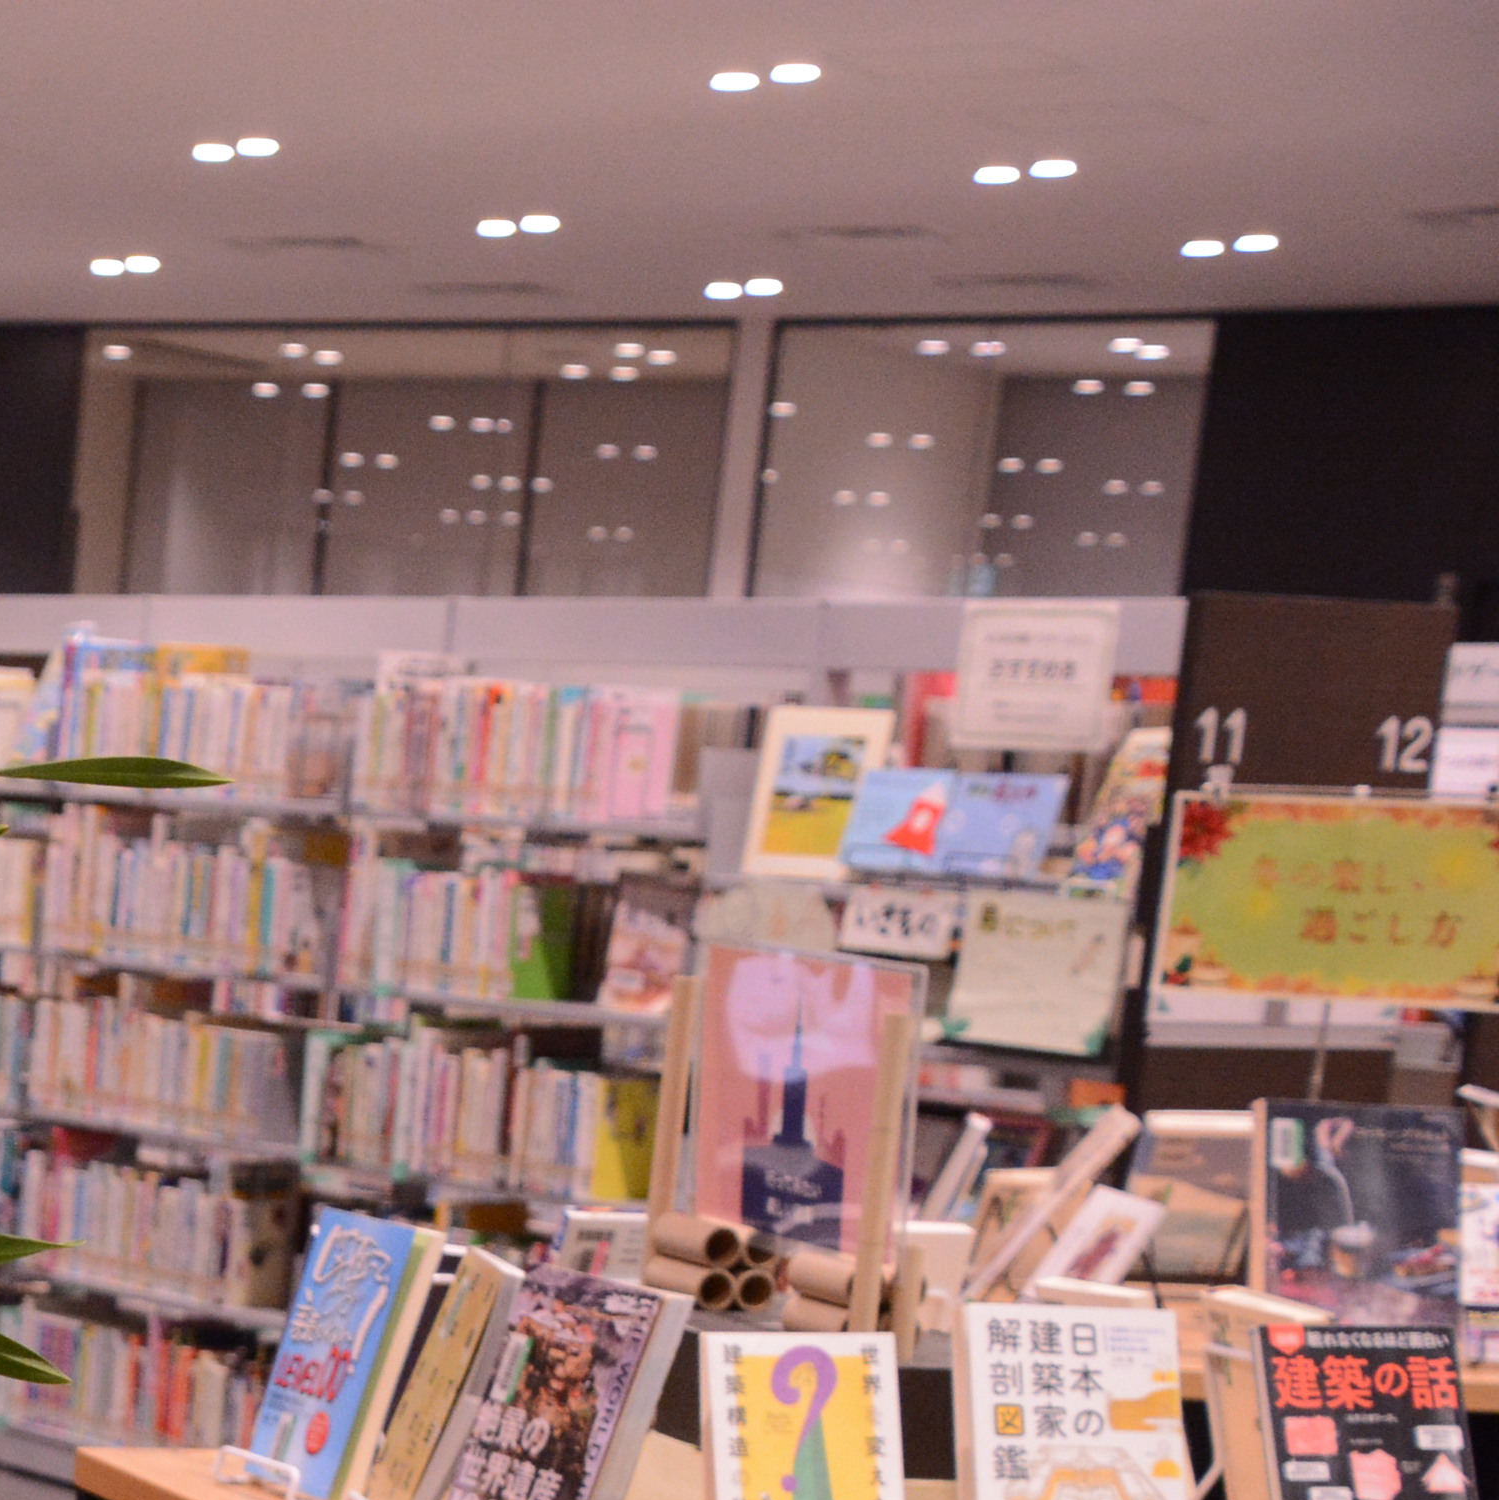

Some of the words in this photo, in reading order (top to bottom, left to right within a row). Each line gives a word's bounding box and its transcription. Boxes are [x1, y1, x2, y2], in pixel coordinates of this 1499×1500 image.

[1194, 706, 1247, 765] 11
[1376, 715, 1434, 773] 12
[987, 1318, 1029, 1481] 解剖図鑑
[1029, 1320, 1067, 1438] 建築家
[1071, 1322, 1105, 1437] 日本の
[1271, 1355, 1460, 1410] 建築の話
